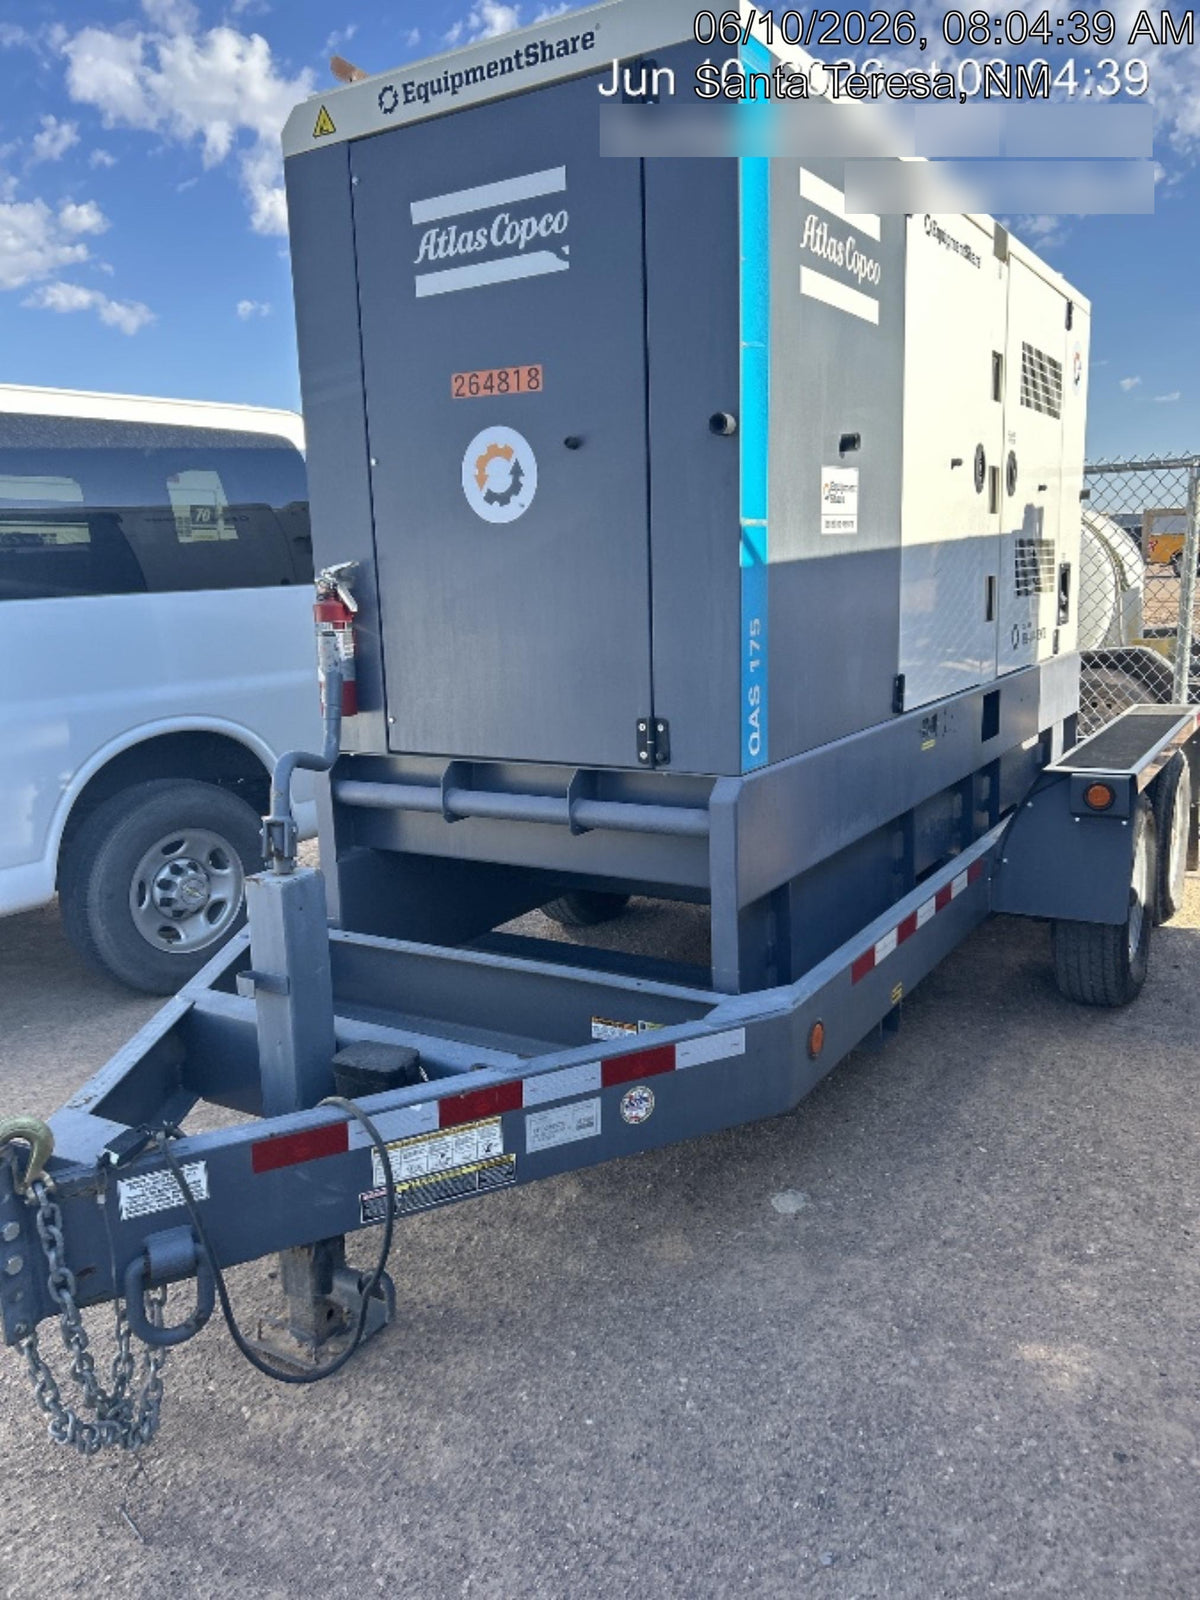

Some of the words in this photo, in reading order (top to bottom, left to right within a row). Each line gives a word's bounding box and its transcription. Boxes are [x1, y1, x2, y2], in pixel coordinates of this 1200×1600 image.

[454, 367, 540, 397] 264818
[749, 618, 761, 673] 175
[748, 684, 761, 756] QAS
